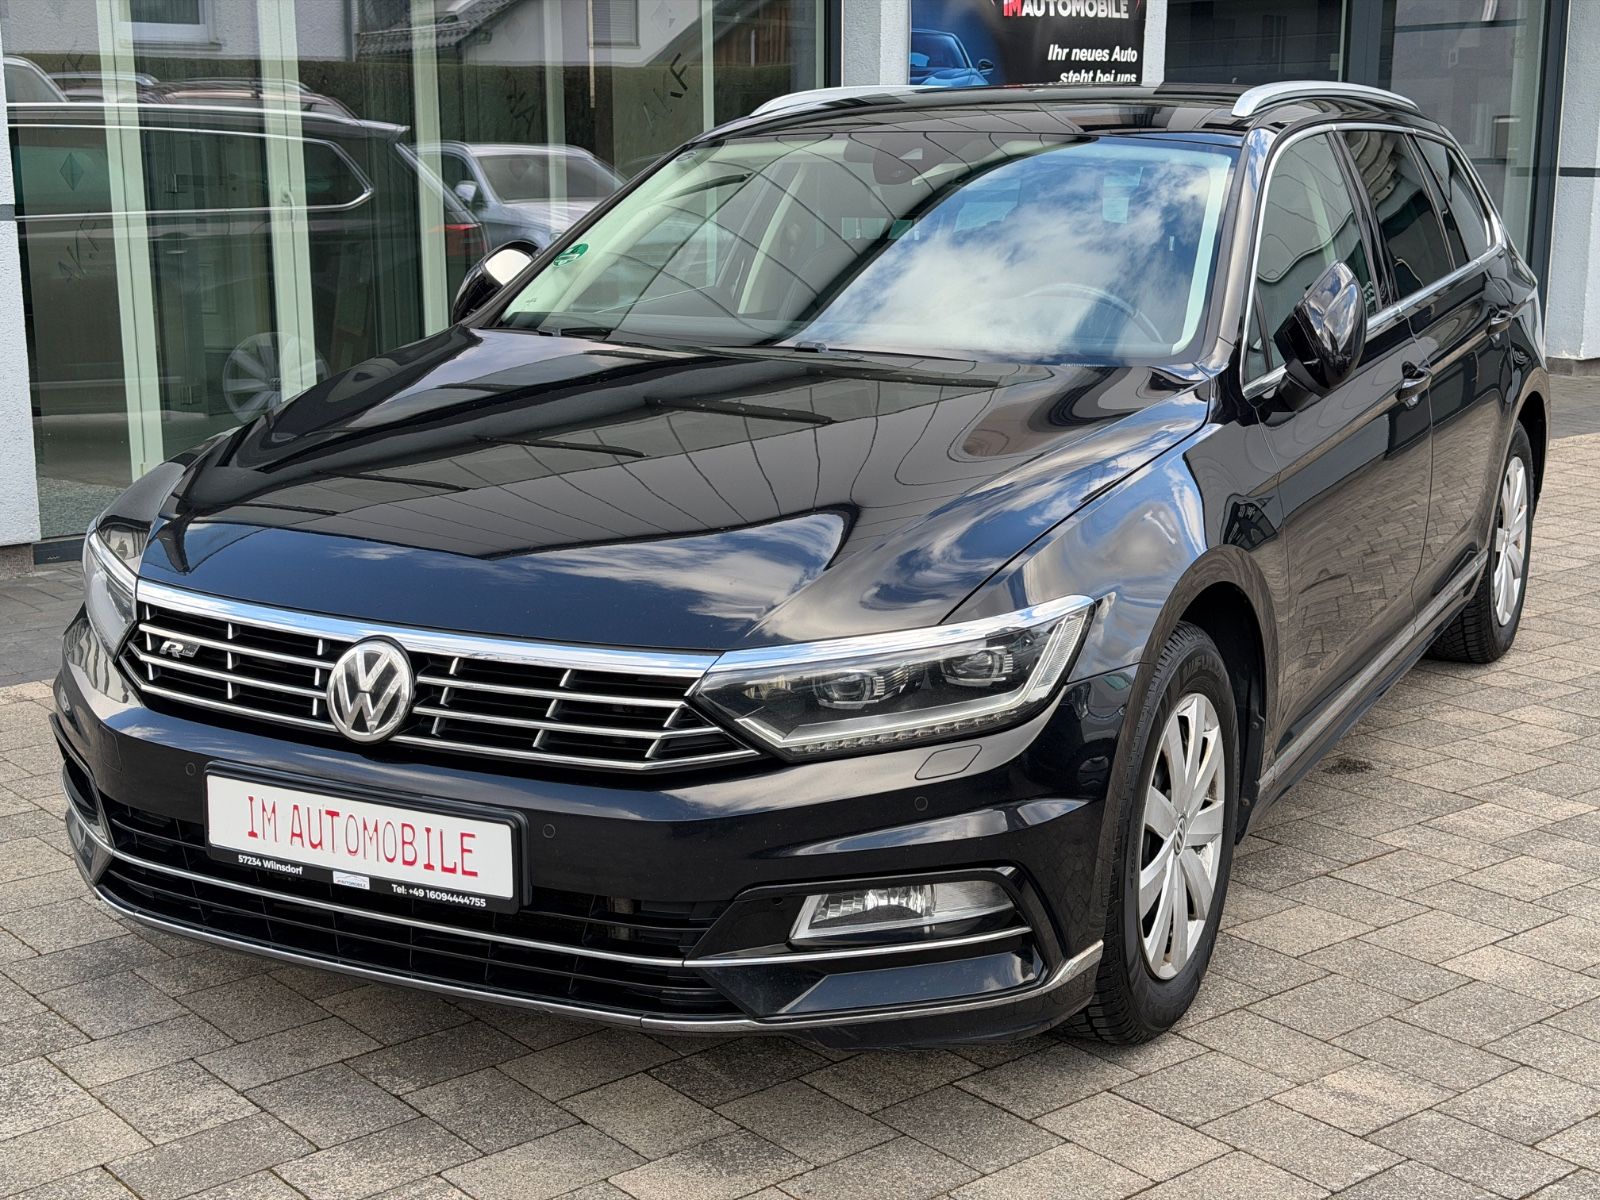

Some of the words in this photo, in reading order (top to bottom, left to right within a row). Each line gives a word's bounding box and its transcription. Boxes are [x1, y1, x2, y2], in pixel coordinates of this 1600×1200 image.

[1003, 0, 1129, 19] IMAUTOMOBILE
[1048, 44, 1070, 61] Ihr
[1071, 48, 1109, 62] neues
[1111, 45, 1138, 63] Auto
[1060, 69, 1094, 83] steht
[1095, 69, 1115, 83] bei
[1116, 71, 1137, 83] uns
[247, 795, 278, 843] IM
[290, 804, 478, 878] AUTOMOBILE
[238, 854, 262, 867] 57234
[262, 860, 303, 875] Wilnsdorf
[391, 883, 408, 894] Tel:
[408, 887, 425, 897] +49
